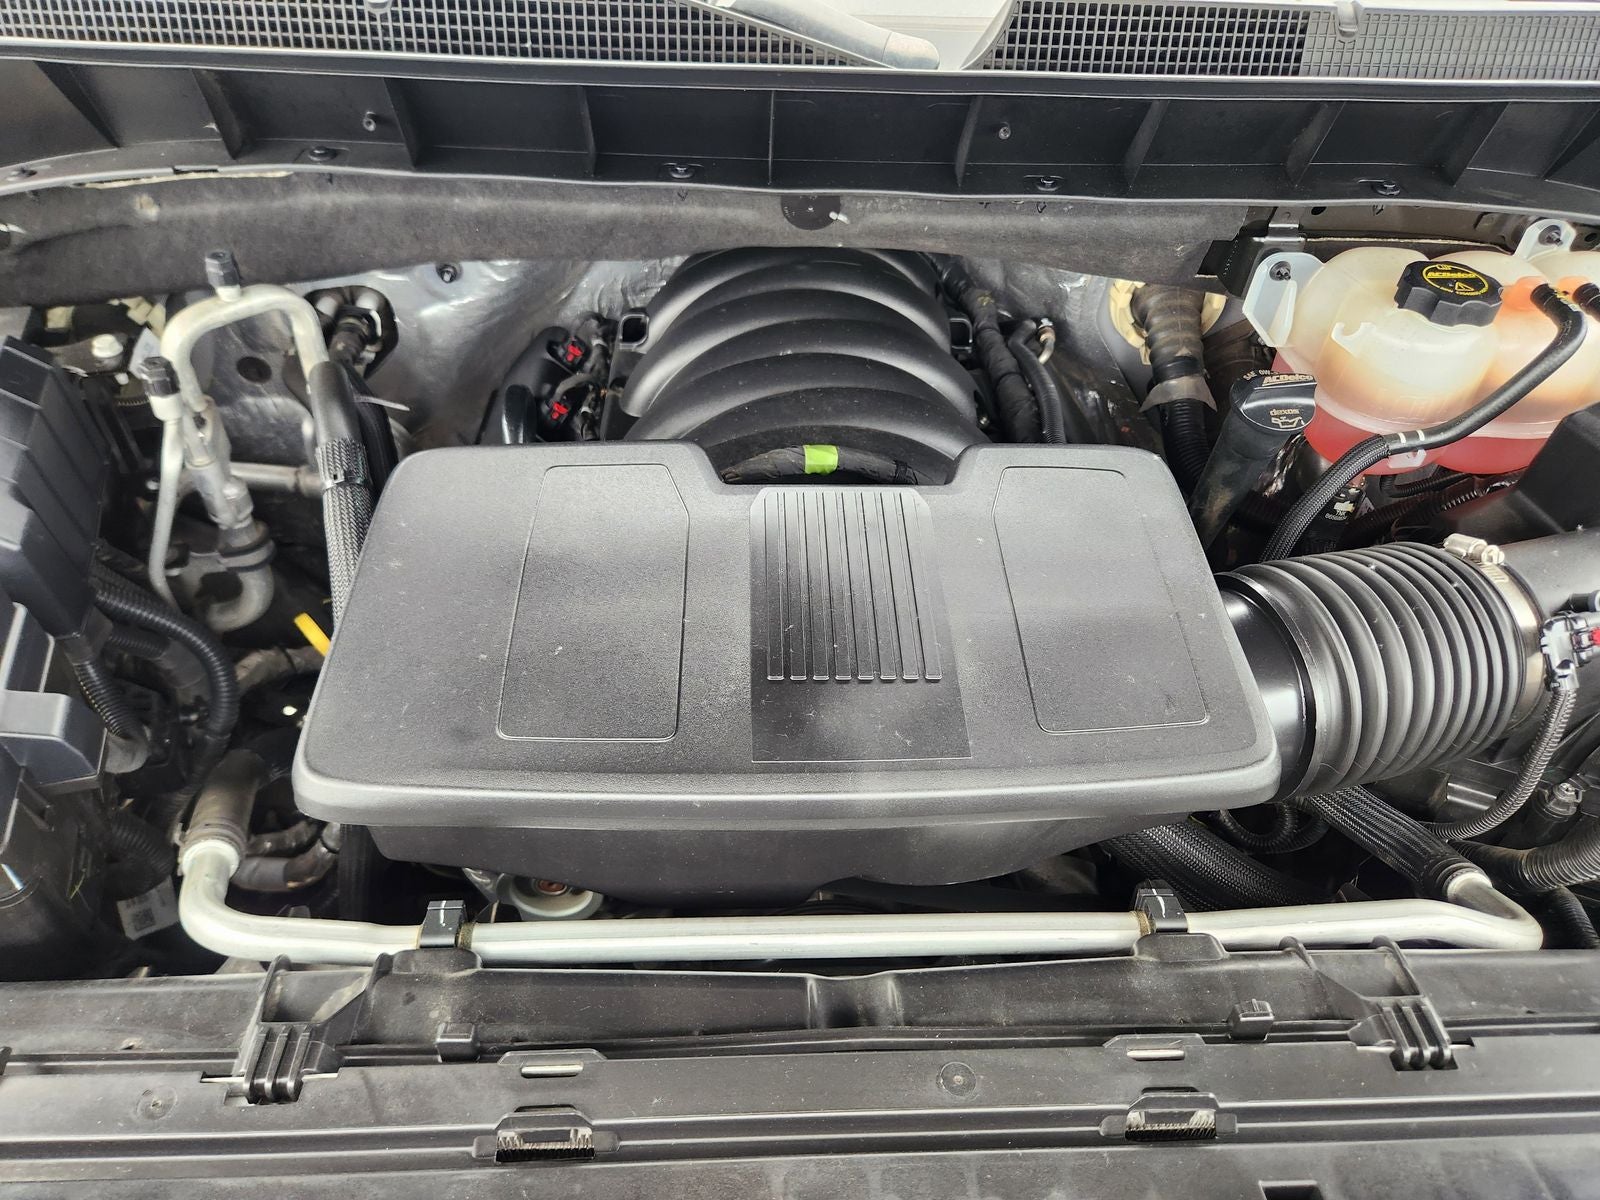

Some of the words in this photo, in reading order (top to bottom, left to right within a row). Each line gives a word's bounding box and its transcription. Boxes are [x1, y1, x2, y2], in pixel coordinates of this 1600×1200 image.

[1243, 371, 1257, 380] SAE
[1262, 374, 1314, 386] ACDelco
[1270, 408, 1300, 416] dexos
